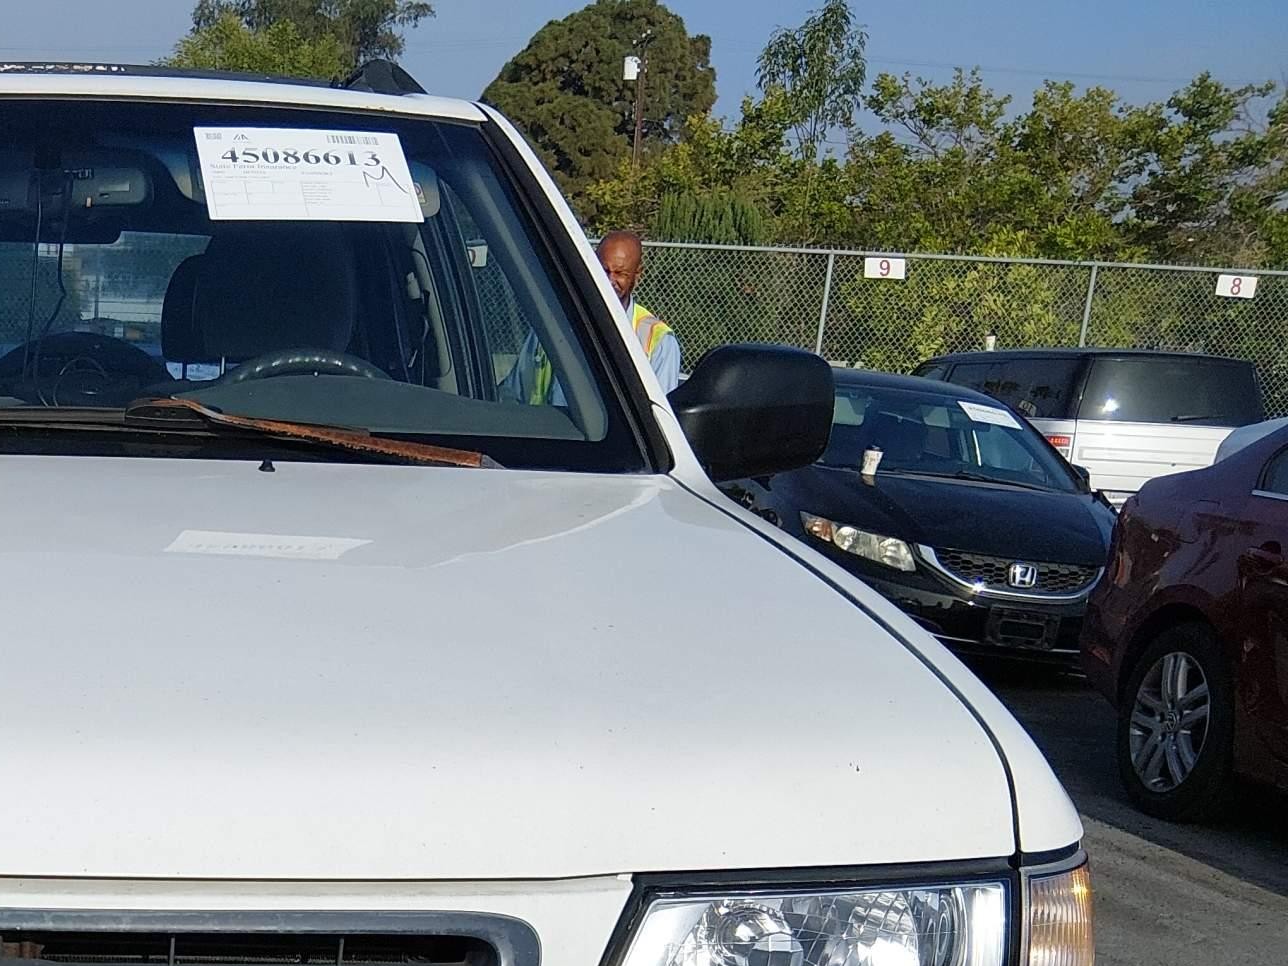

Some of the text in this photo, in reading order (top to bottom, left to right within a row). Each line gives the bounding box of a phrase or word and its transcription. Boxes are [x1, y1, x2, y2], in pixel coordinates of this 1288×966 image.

[221, 147, 382, 167] 45086613
[879, 259, 890, 276] 9
[1230, 277, 1242, 295] 8
